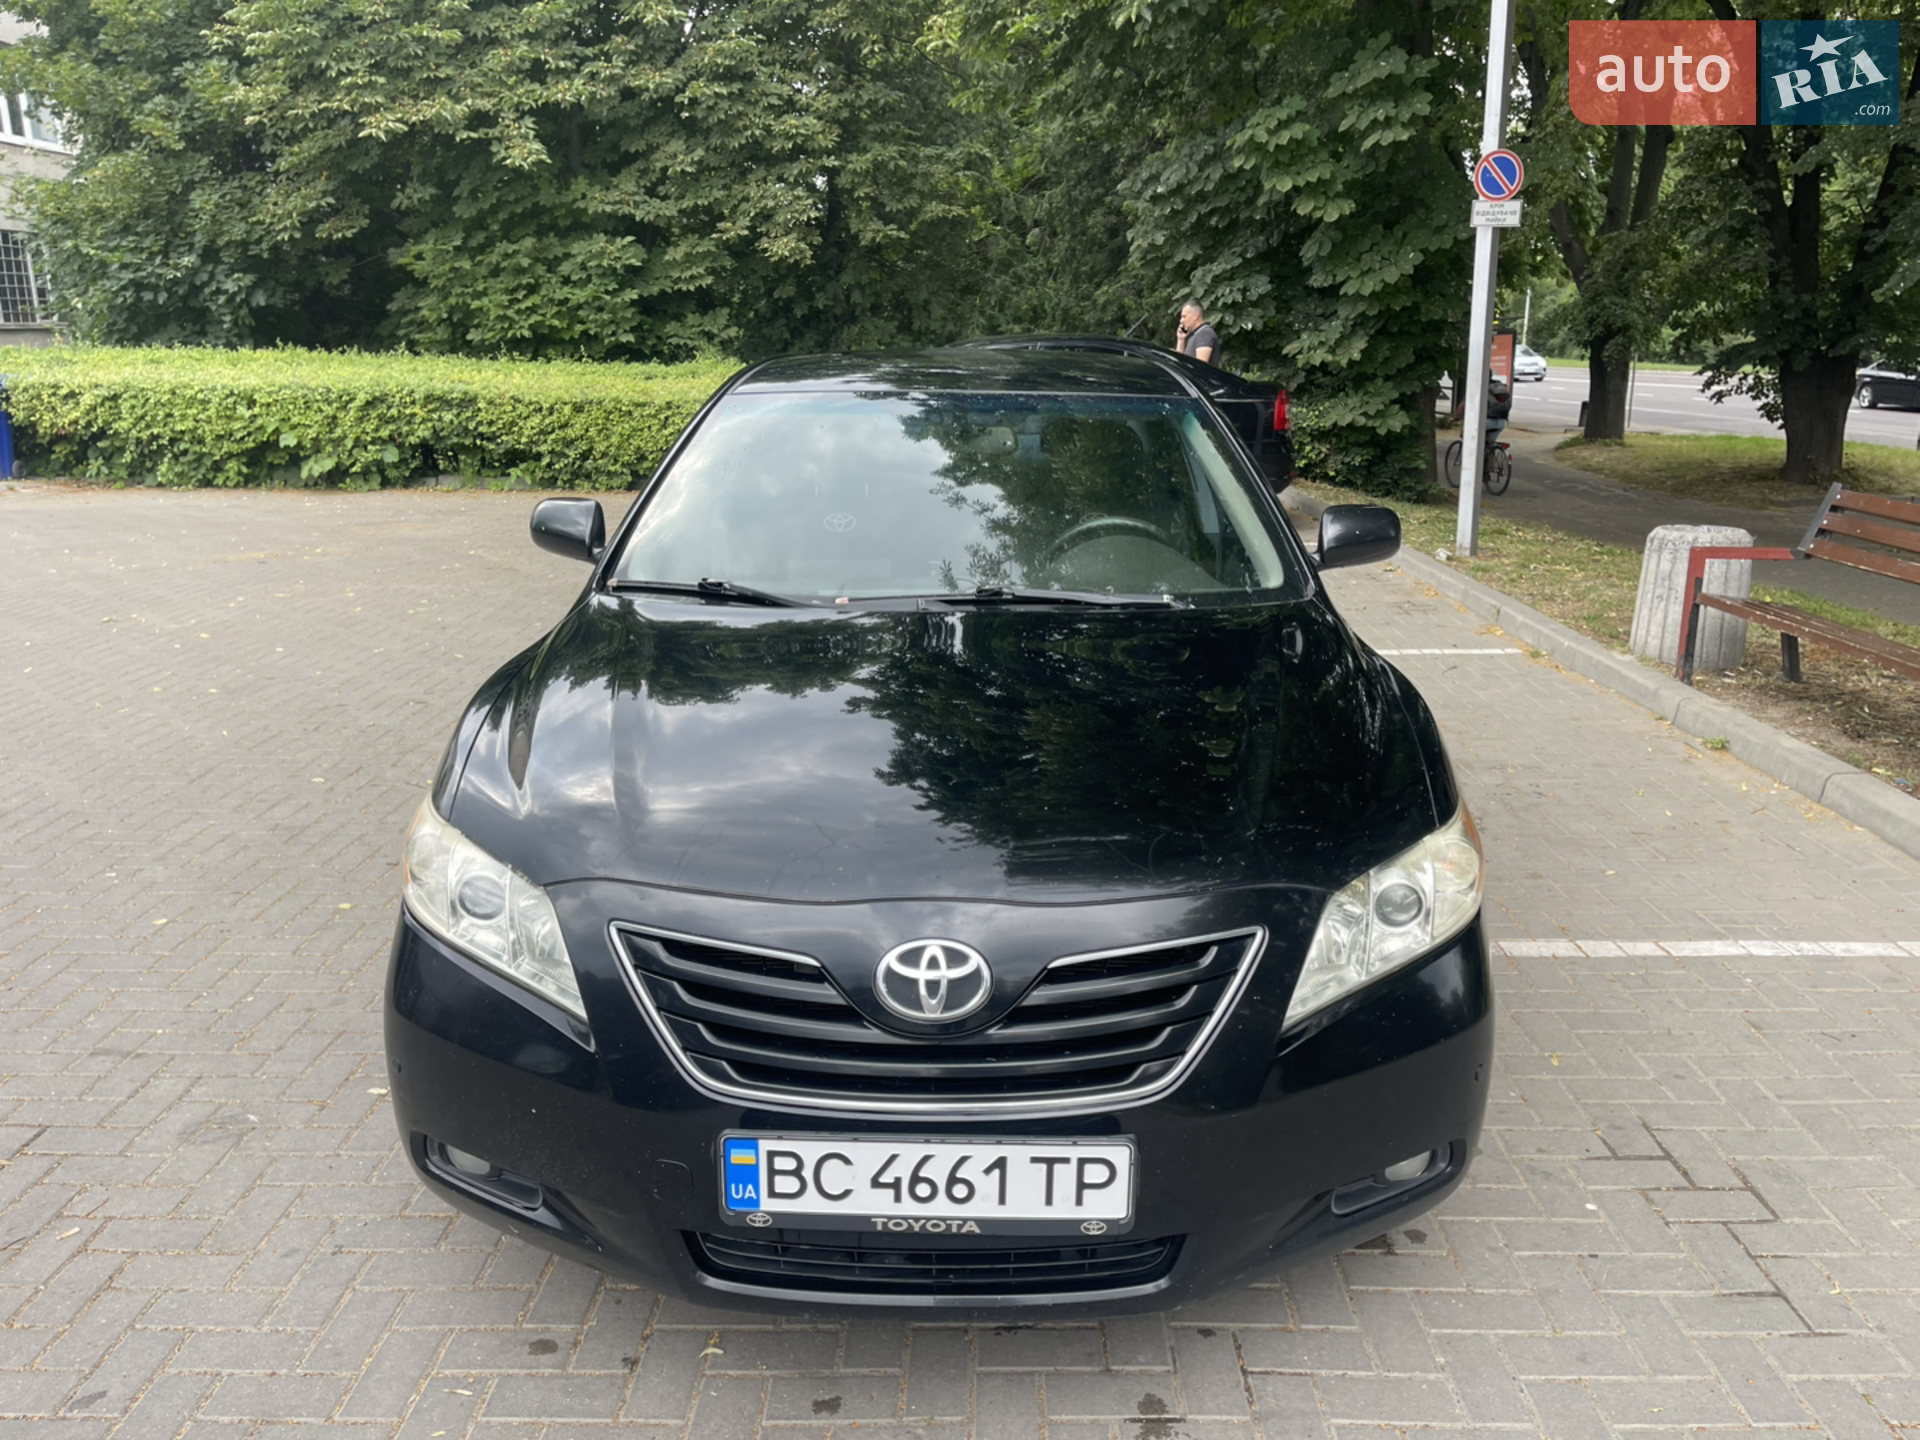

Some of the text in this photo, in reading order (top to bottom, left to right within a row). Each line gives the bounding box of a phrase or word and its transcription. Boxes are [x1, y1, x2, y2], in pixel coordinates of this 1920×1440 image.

[766, 1149, 1118, 1208] BC 4661 TP
[731, 1184, 757, 1201] UA
[871, 1217, 981, 1235] TOYOTA
